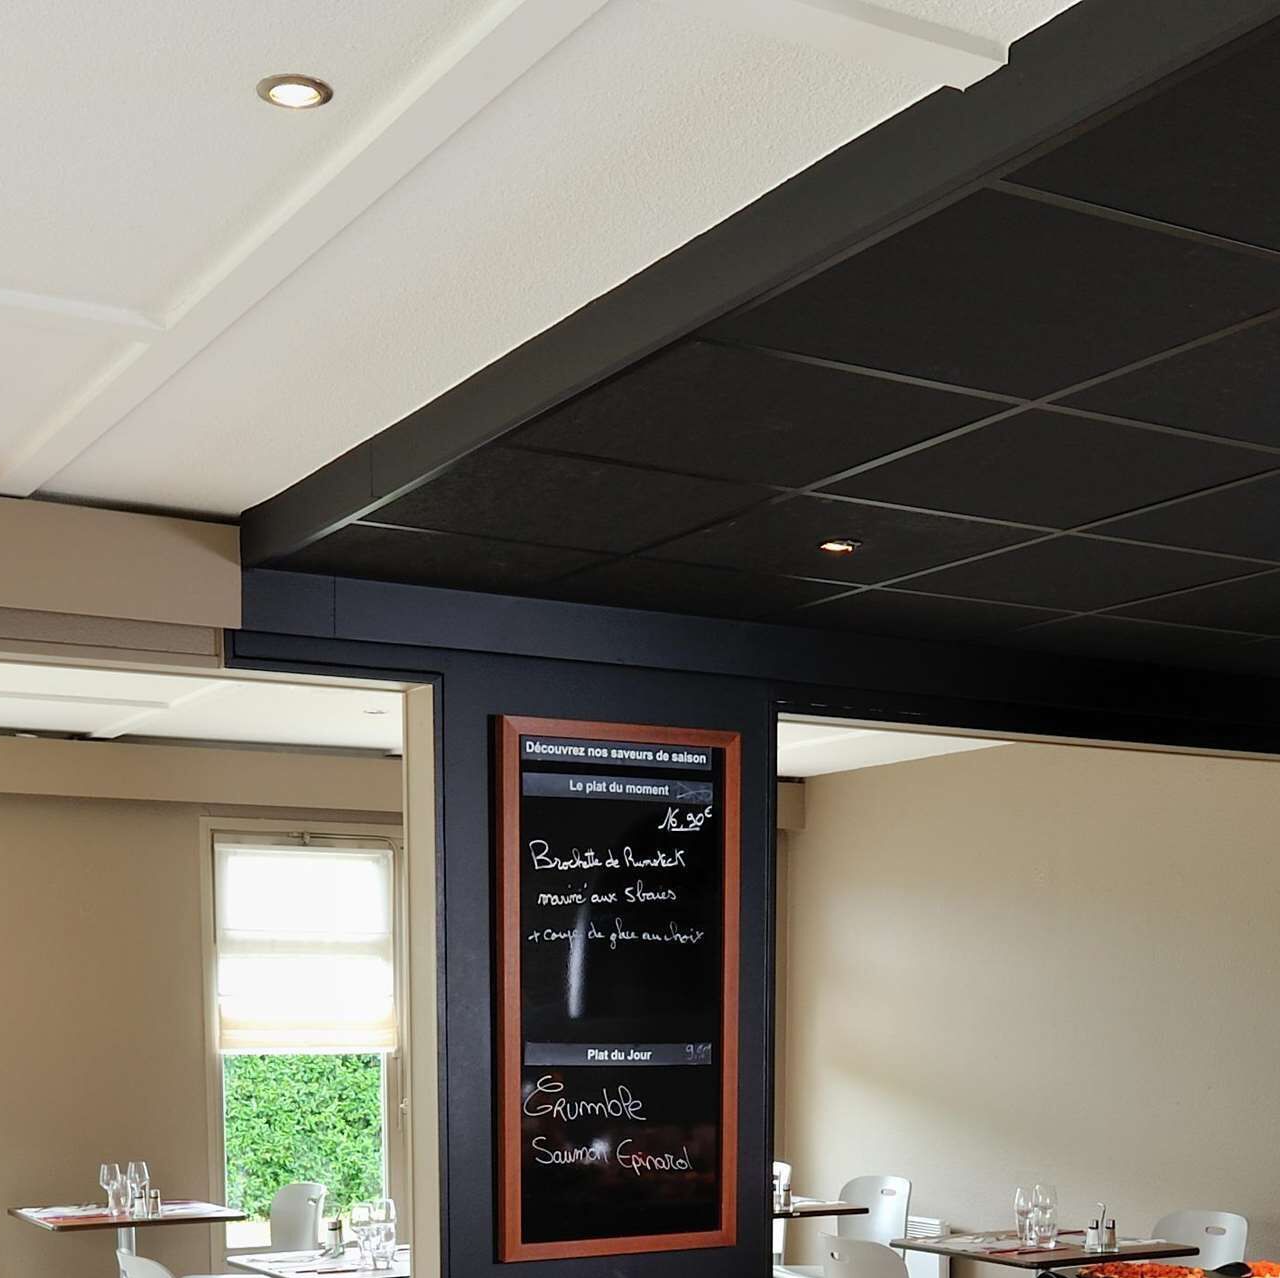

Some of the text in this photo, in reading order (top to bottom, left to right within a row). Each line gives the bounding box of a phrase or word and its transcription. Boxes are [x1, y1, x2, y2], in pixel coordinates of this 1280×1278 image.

[525, 741, 707, 764] Découvrez nos saveurs de saison
[569, 779, 670, 796] Le plat du moment
[528, 839, 603, 870] Brochette
[605, 848, 620, 868] de
[590, 892, 619, 903] aux
[587, 921, 606, 939] de
[587, 1049, 653, 1061] Plat du Jour
[531, 1136, 609, 1165] Saumon
